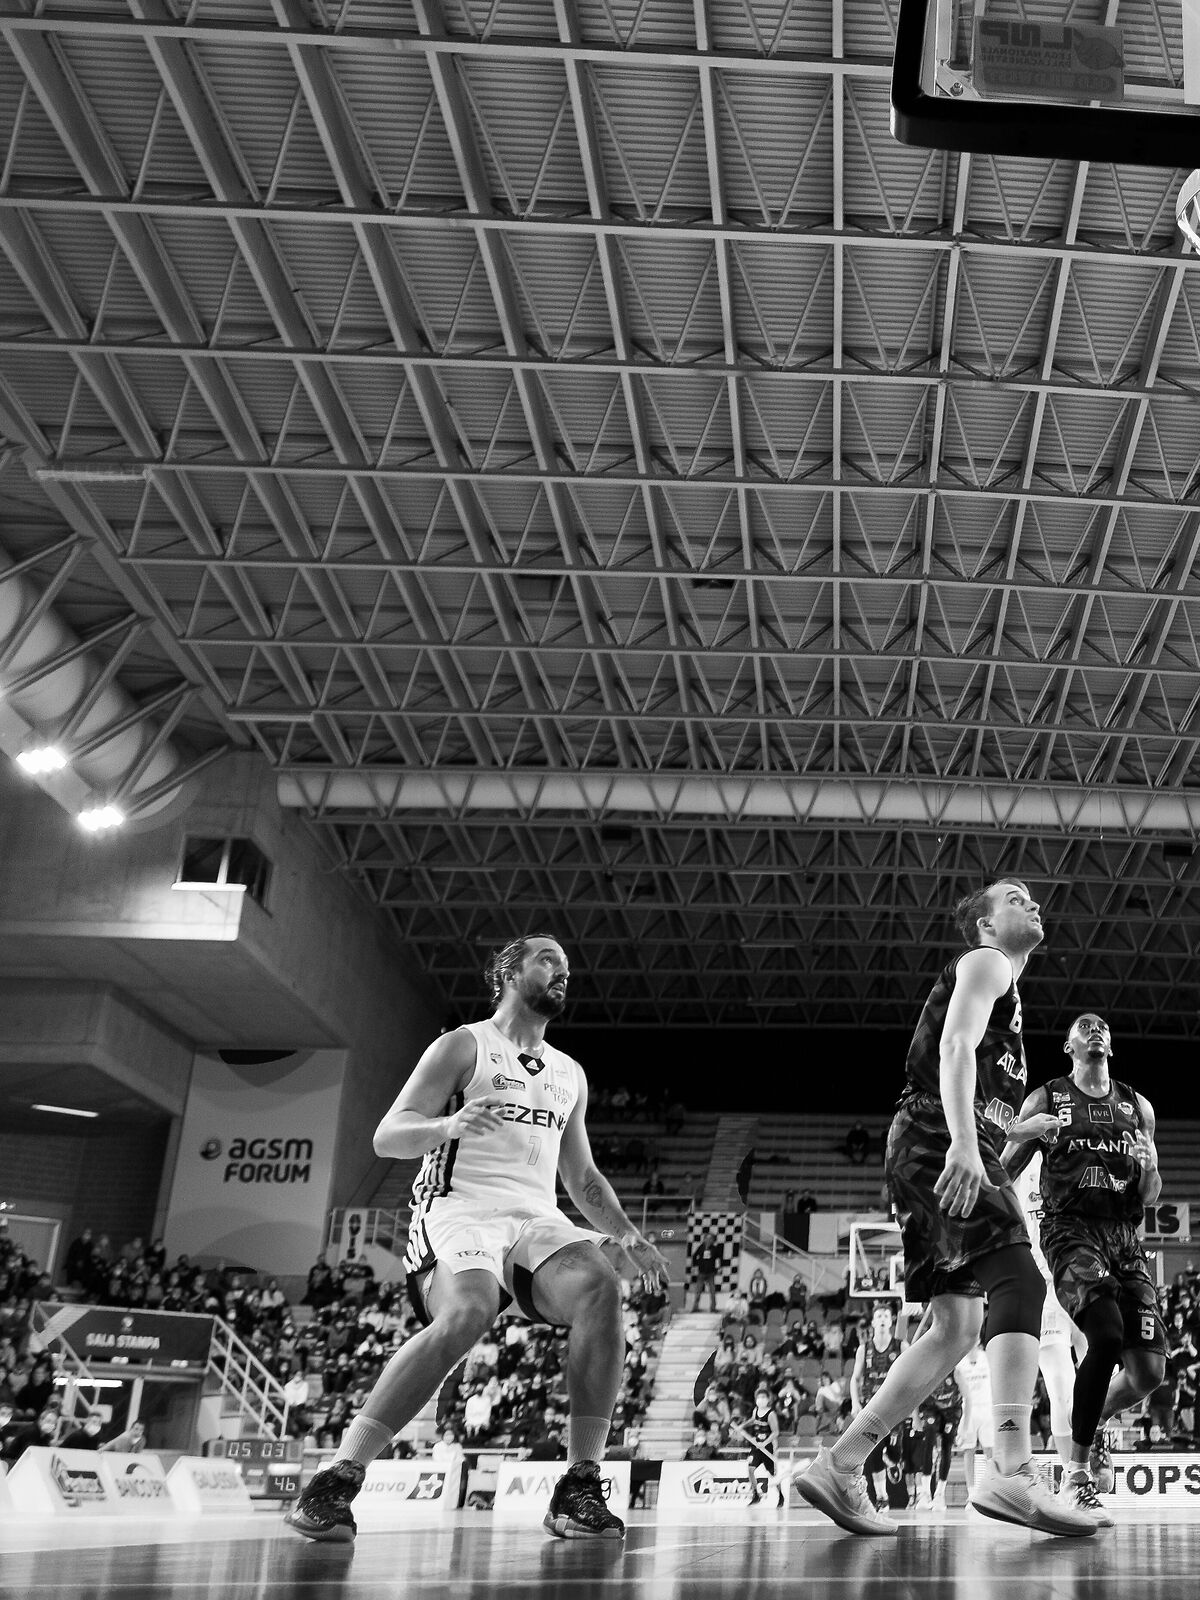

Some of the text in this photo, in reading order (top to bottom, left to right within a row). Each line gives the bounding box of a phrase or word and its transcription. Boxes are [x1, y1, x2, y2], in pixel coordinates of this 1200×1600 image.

[1058, 1107, 1072, 1127] 5
[1092, 1109, 1109, 1118] EVR
[223, 1163, 311, 1184] FORUM
[1140, 1316, 1155, 1340] 5
[228, 1441, 284, 1458] 05 03
[274, 1477, 296, 1491] 46
